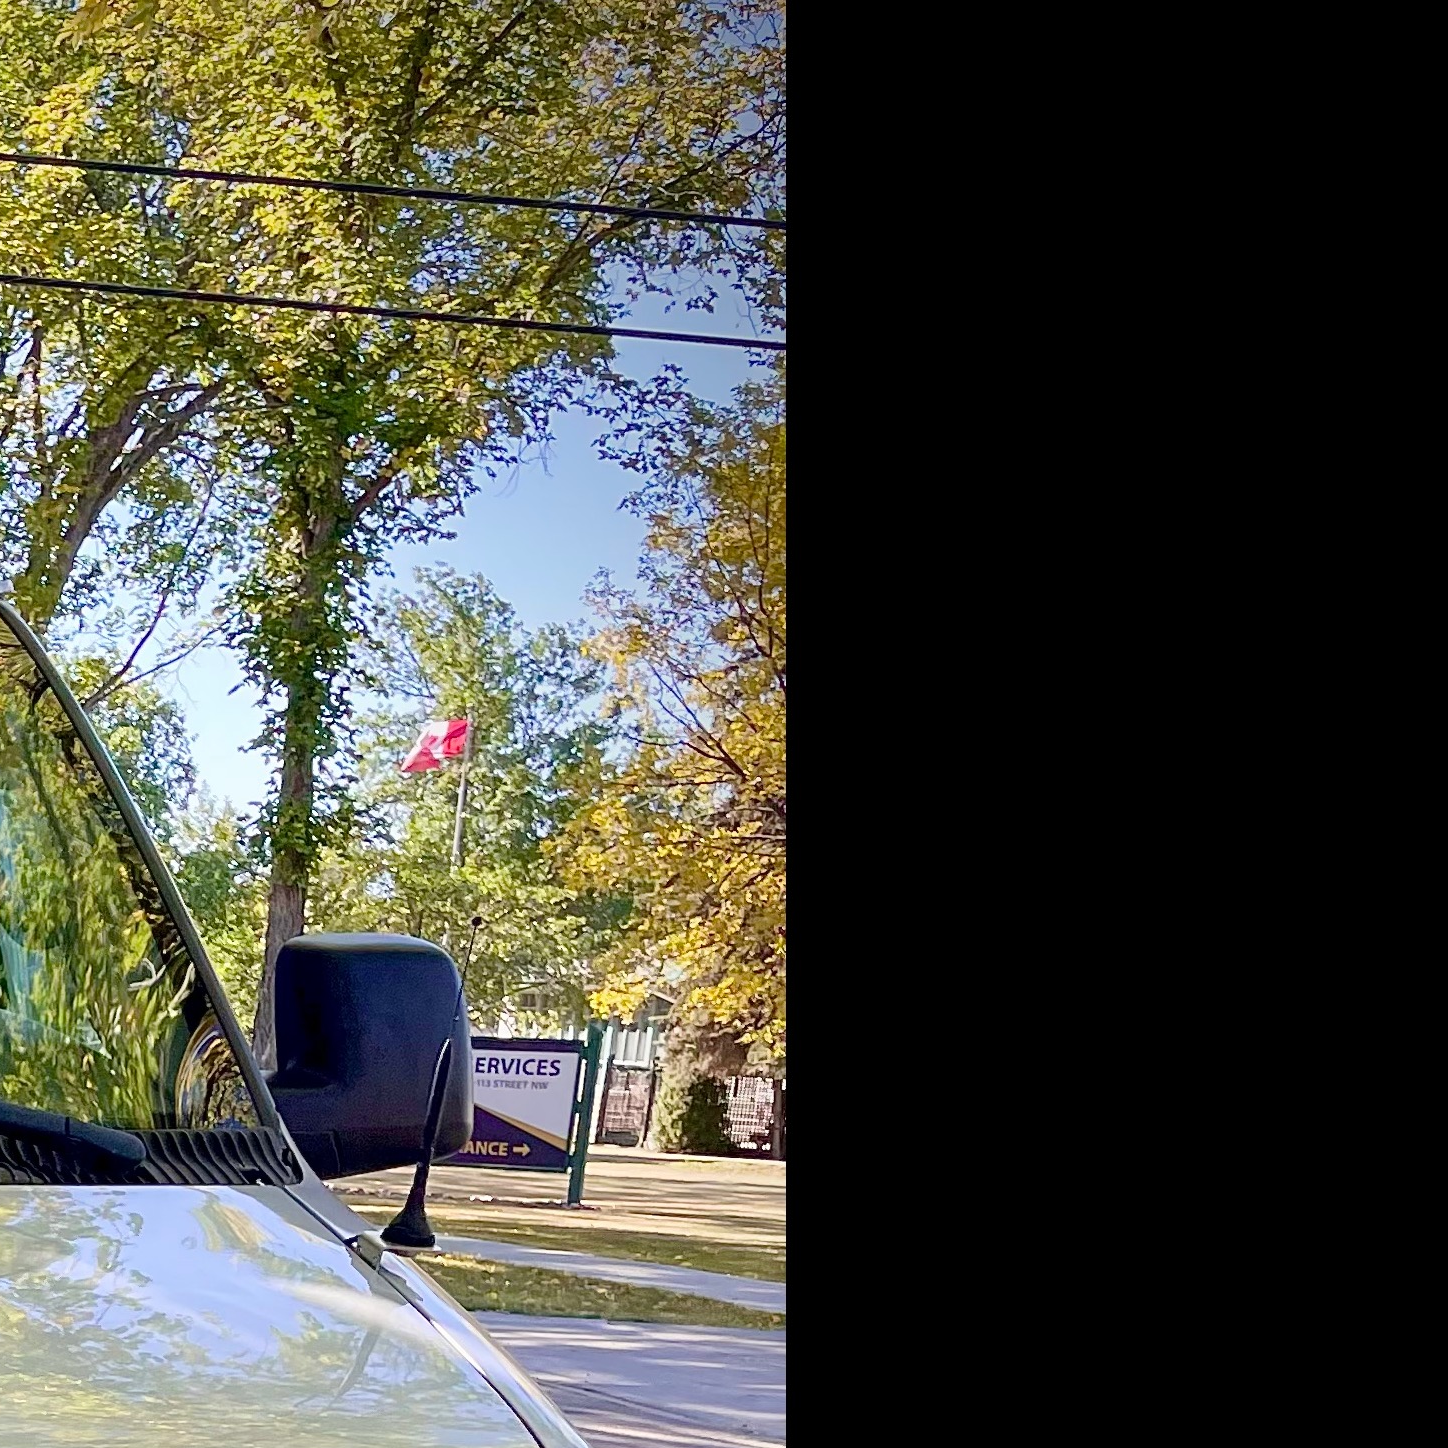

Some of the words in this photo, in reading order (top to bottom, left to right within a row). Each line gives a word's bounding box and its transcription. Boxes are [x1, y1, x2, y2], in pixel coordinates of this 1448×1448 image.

[474, 1057, 561, 1077] ERVICES
[493, 1079, 528, 1090] STREET
[530, 1081, 549, 1090] NW
[458, 1140, 509, 1156] ANCE
